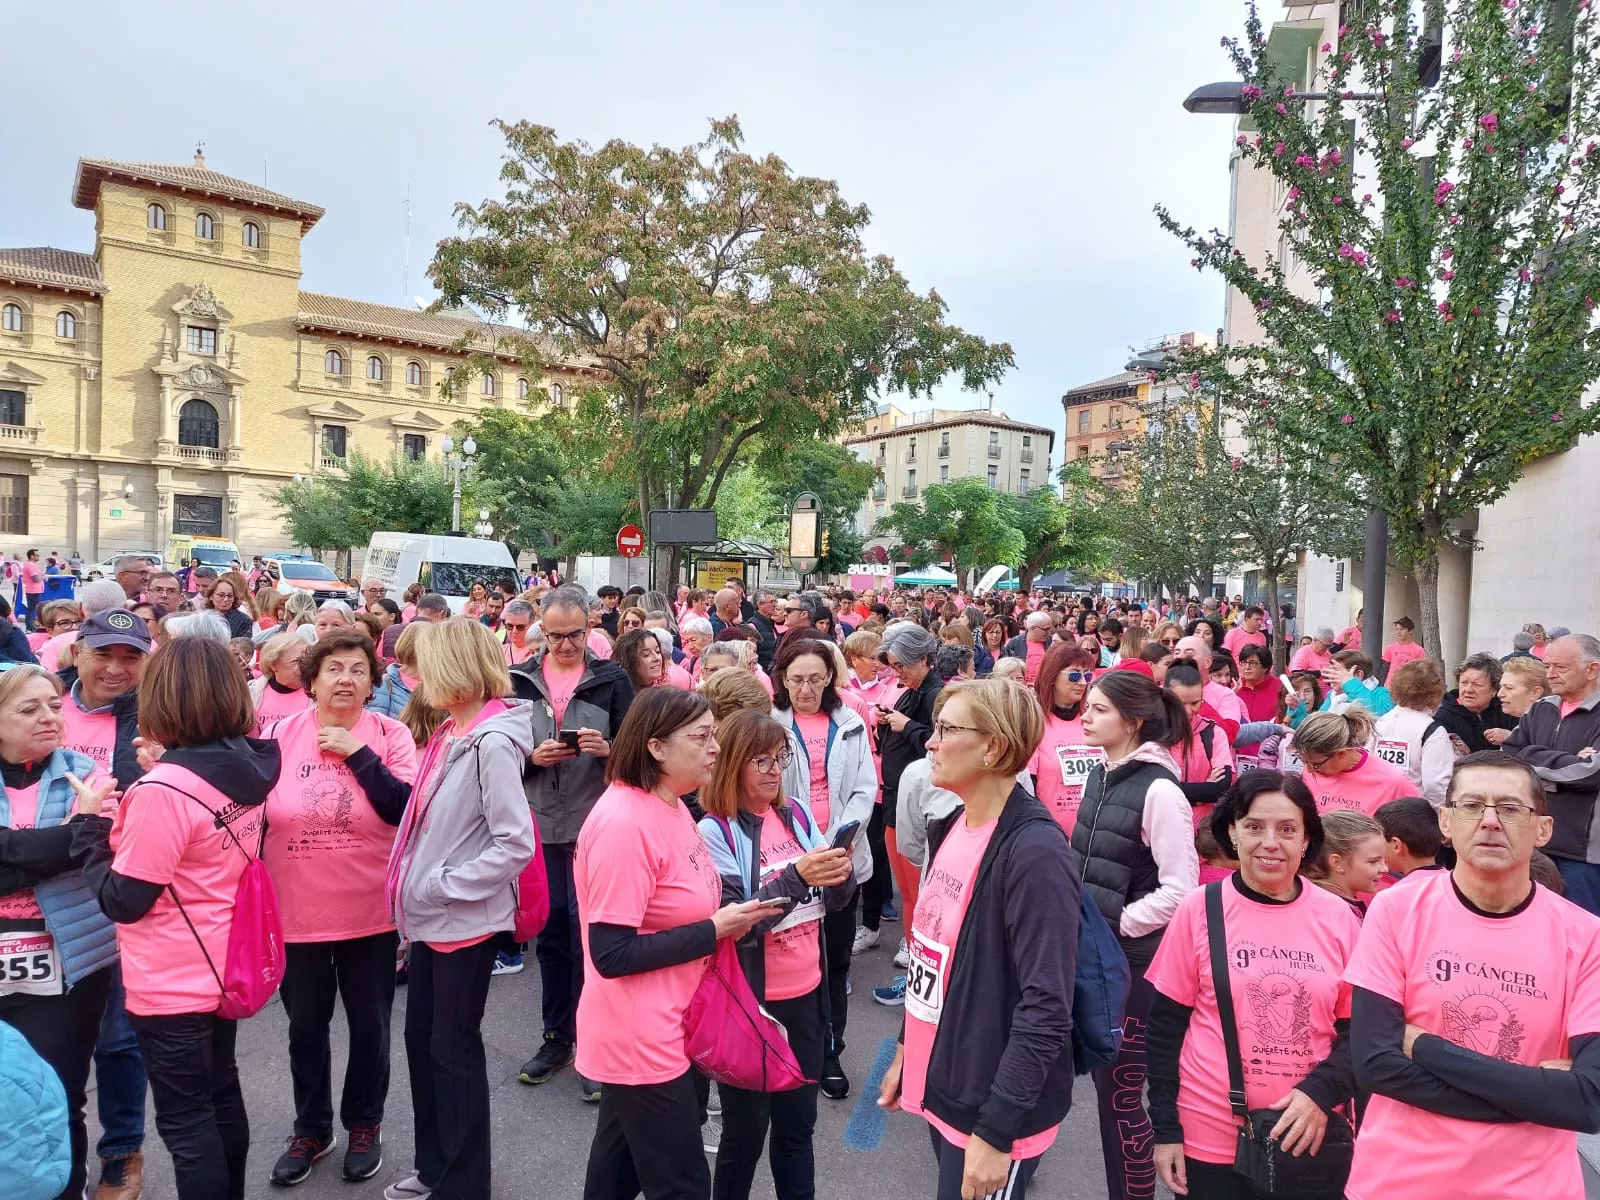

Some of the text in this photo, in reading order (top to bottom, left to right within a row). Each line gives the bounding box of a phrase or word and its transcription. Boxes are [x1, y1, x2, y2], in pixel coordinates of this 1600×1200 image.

[1065, 758, 1101, 776] 308
[15, 942, 49, 953] CÁNCER
[1236, 949, 1256, 968] 9ª
[1259, 945, 1315, 963] CÁNCER
[1289, 960, 1325, 973] HUESCA
[1435, 958, 1536, 987] 9ª CÁNCER
[1501, 983, 1548, 1000] HUESCA
[1251, 1044, 1290, 1056] QUIÉRETE
